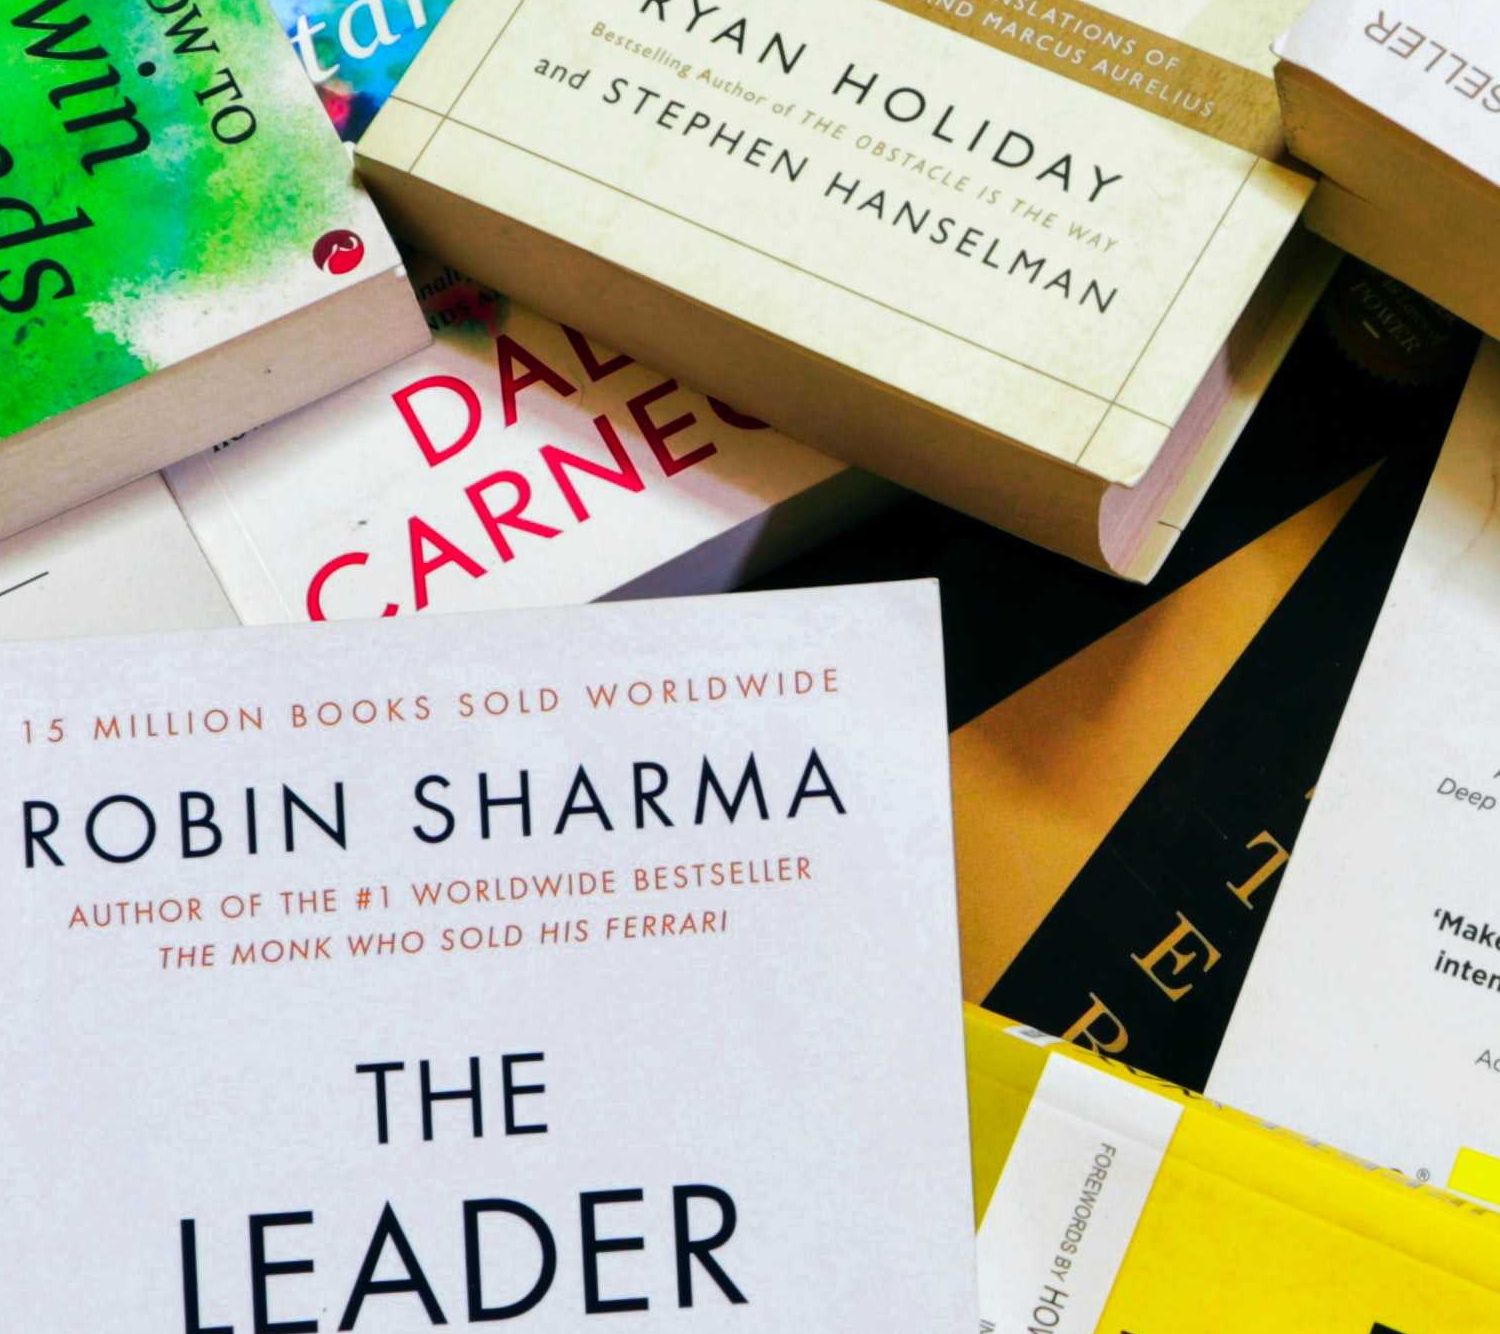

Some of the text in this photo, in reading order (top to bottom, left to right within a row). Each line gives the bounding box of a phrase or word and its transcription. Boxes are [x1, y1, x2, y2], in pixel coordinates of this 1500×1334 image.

[192, 62, 256, 148] TO
[831, 62, 1122, 201] HOLIDAY
[533, 58, 1118, 312] and STEPHEN HANSELMAN
[22, 667, 837, 744] 15 MILLION BOOKS SOLD WORLDWIDE
[22, 747, 846, 868] ROBIN SHARMA
[354, 1051, 548, 1144] THE
